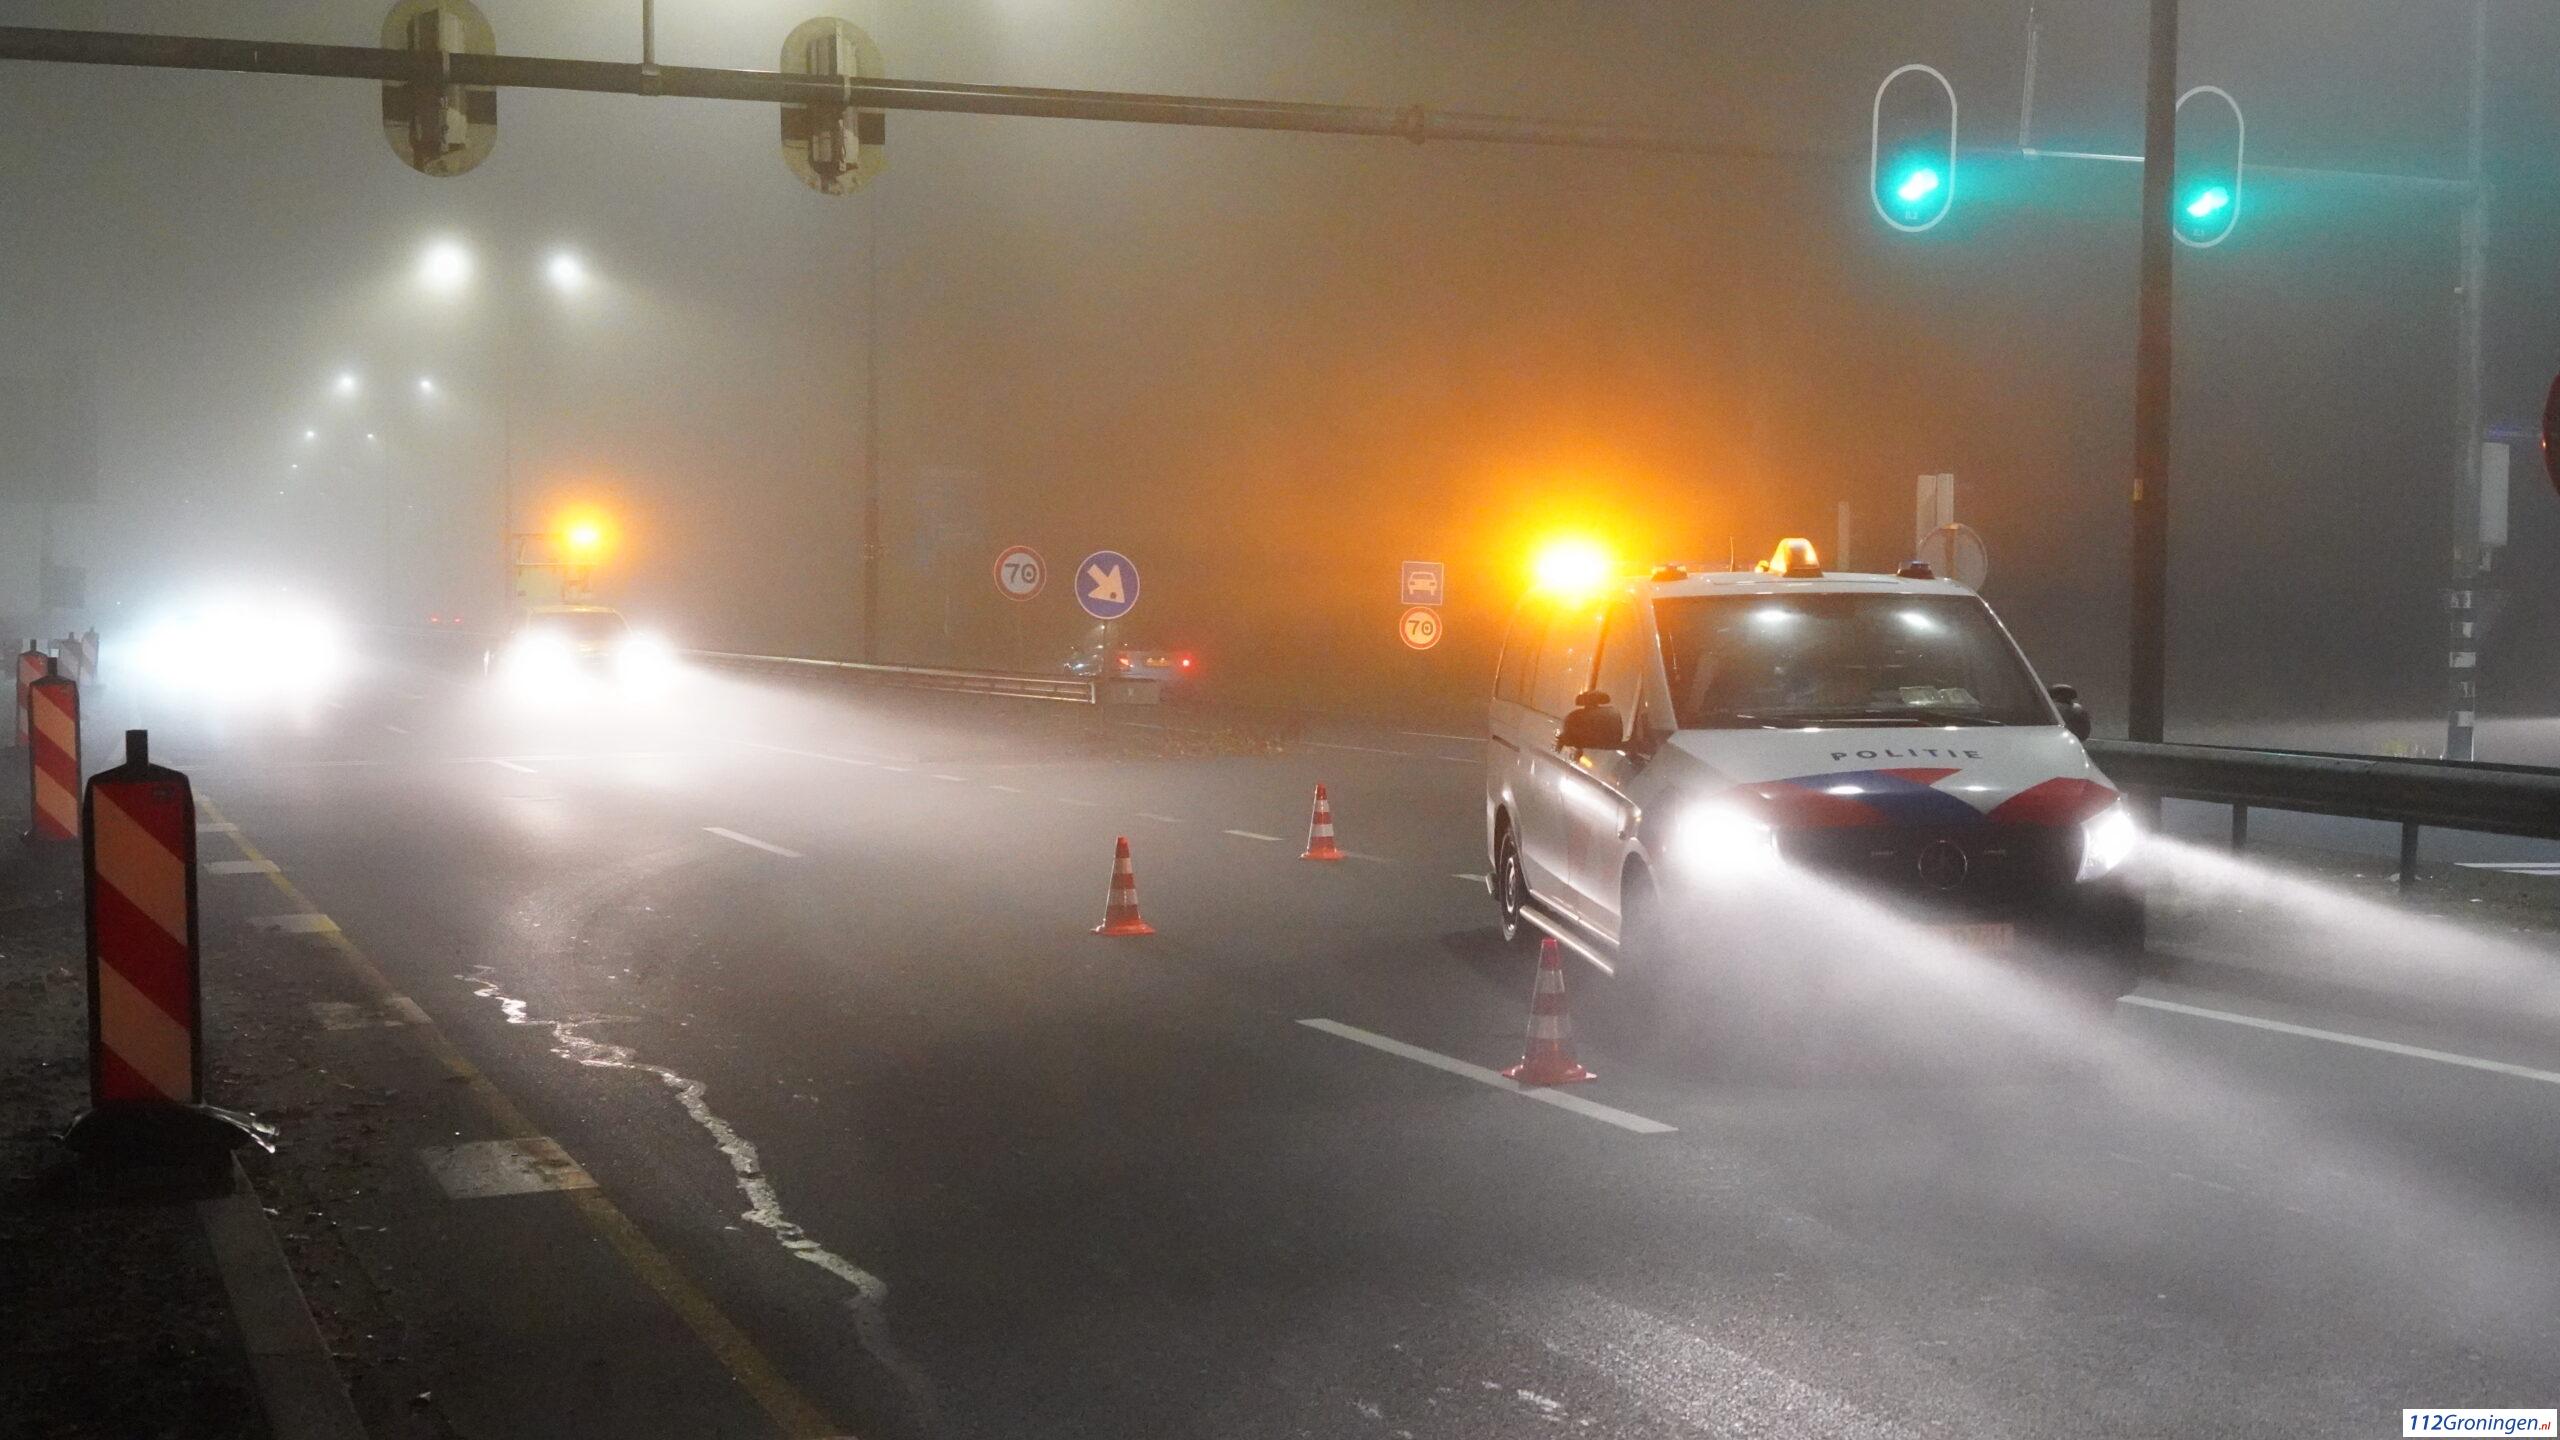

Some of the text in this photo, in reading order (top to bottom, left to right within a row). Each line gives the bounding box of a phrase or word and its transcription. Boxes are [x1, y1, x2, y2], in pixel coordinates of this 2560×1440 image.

[1004, 563, 1037, 584] 70
[1408, 619, 1434, 636] 70
[1830, 748, 1984, 762] POLITIE
